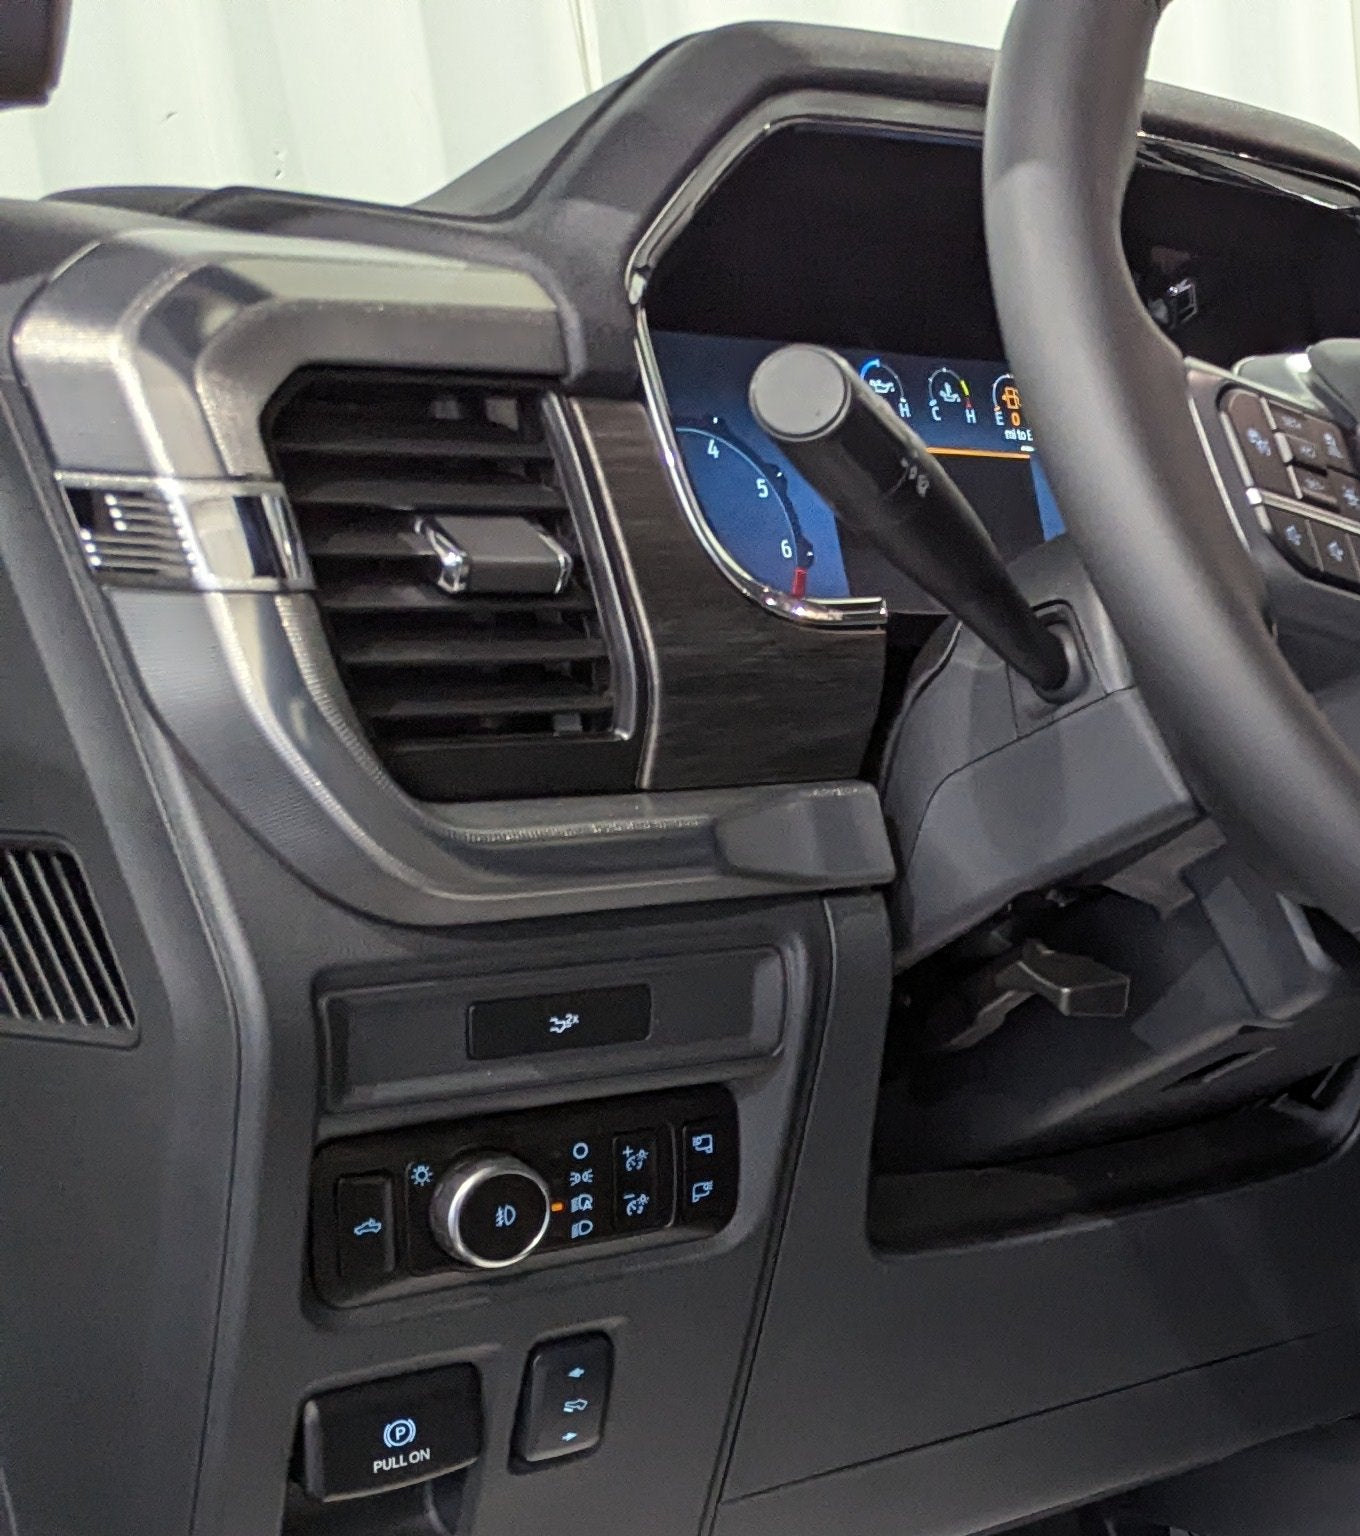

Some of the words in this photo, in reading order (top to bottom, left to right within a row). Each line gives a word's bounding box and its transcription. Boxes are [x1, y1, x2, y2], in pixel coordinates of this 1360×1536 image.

[898, 402, 911, 418] H
[931, 406, 941, 421] C
[965, 409, 977, 424] H
[994, 411, 1004, 426] E
[1017, 430, 1026, 441] to
[707, 439, 720, 459] 4
[756, 478, 769, 498] 5
[781, 539, 793, 559] 6
[373, 1454, 408, 1474] PULL
[408, 1447, 431, 1464] ON
